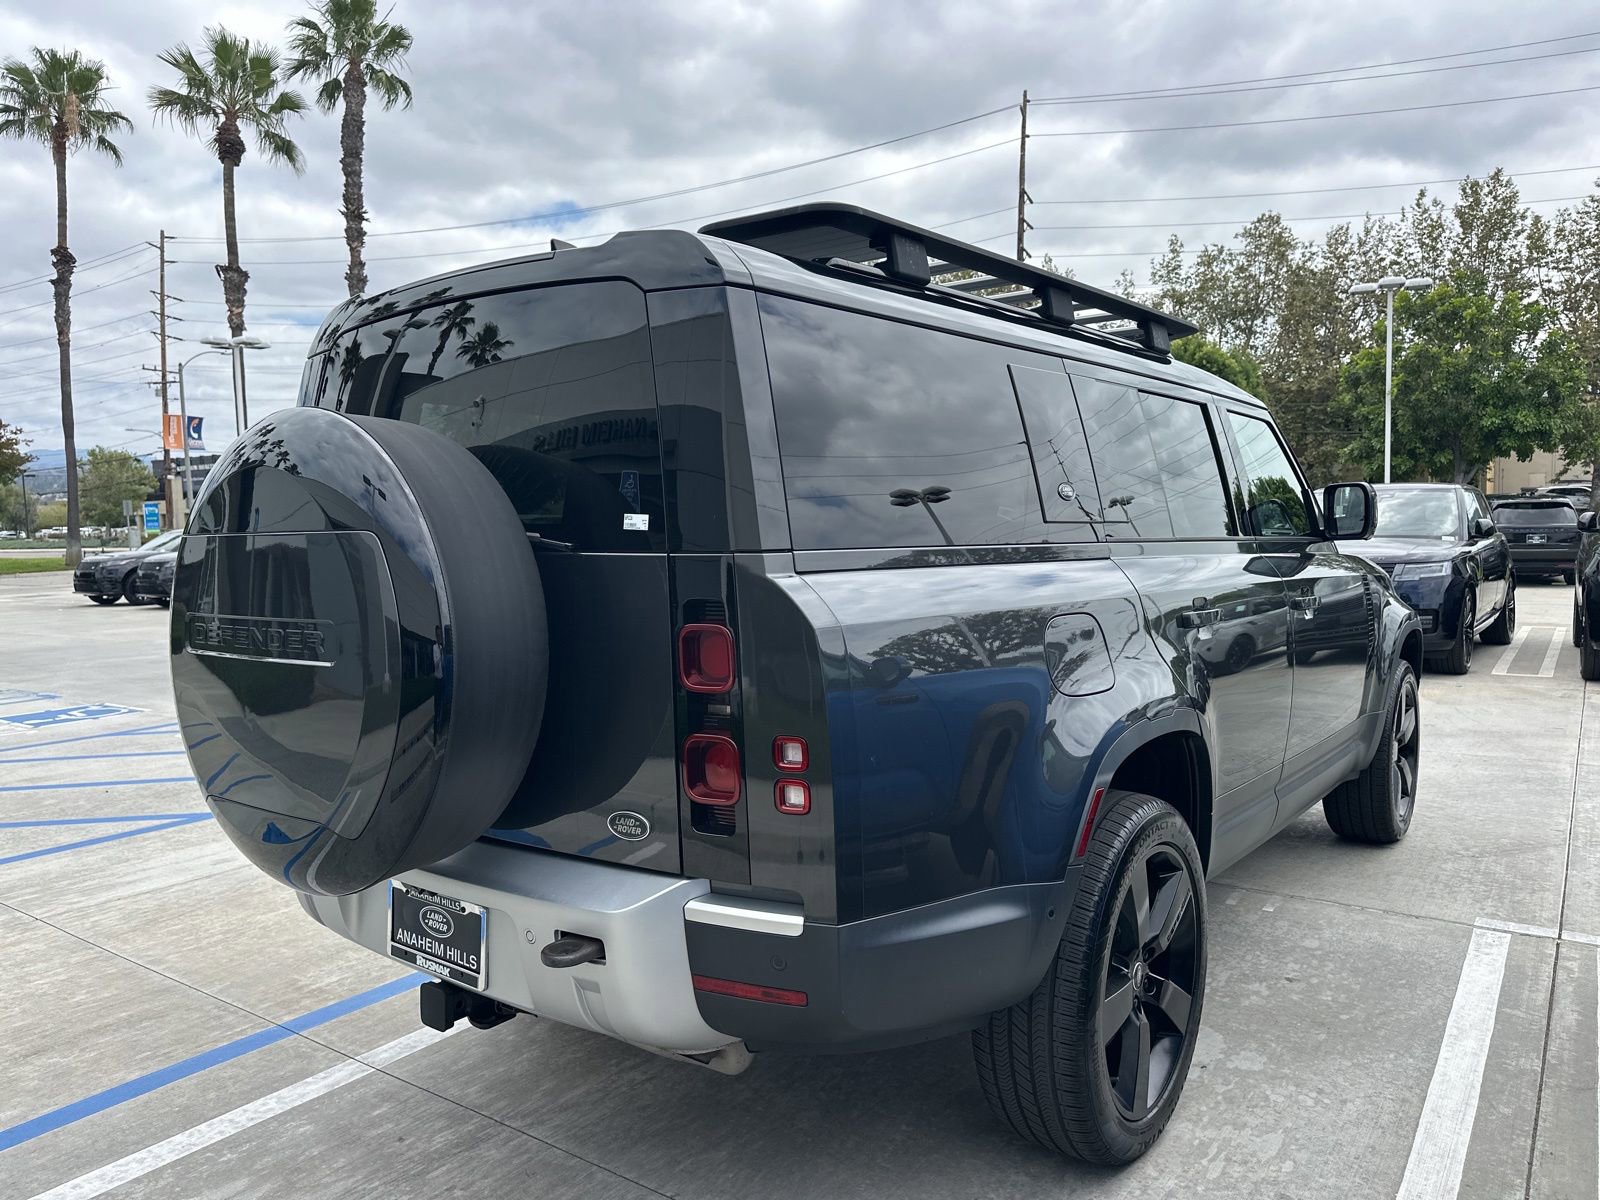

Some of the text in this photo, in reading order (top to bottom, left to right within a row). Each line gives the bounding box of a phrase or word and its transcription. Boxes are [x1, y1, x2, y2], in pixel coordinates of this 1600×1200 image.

[194, 622, 325, 653] DEFENDER
[615, 816, 635, 827] LAND
[617, 824, 642, 835] ROVER
[441, 897, 460, 911] HILLS
[426, 910, 443, 922] LAND
[428, 919, 448, 932] ROVER
[396, 927, 477, 970] ANAHEIM HILLS
[416, 955, 451, 977] RUSNAK
